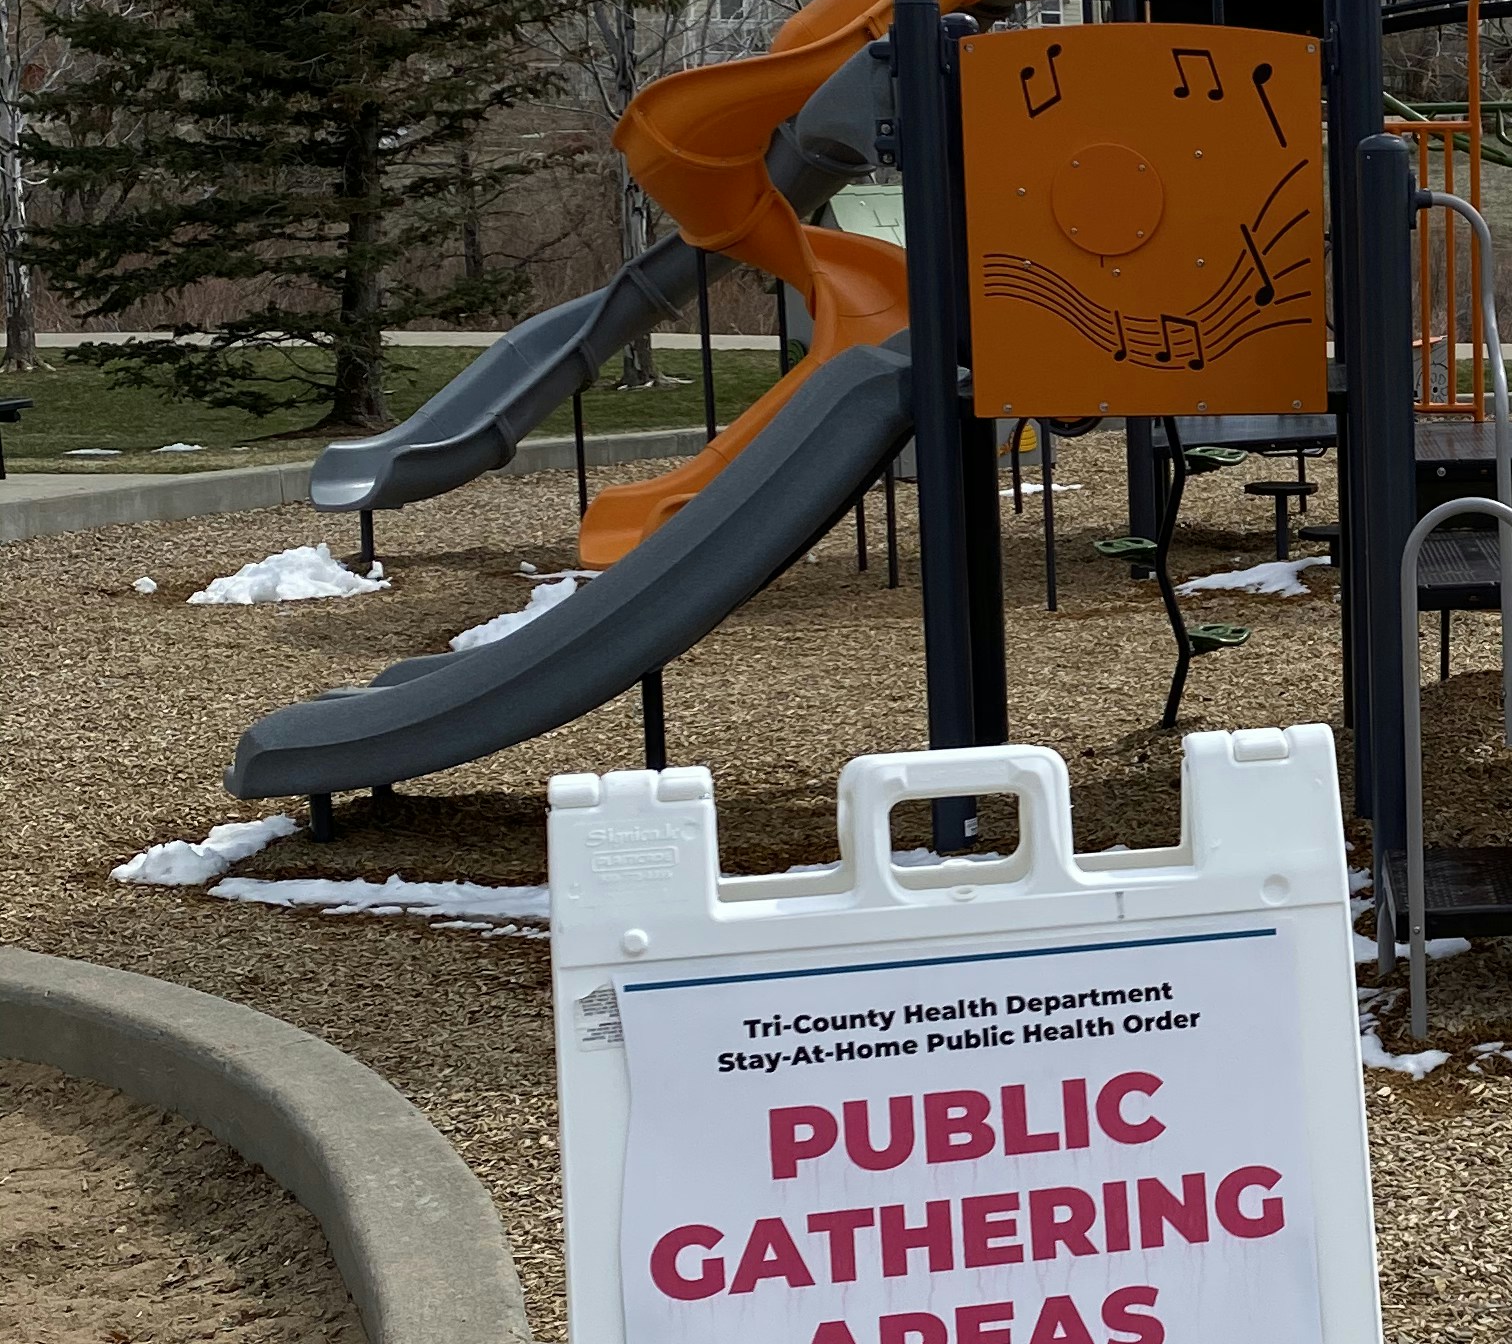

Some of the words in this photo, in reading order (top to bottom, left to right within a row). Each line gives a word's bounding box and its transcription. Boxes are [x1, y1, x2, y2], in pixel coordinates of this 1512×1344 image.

[717, 1039, 919, 1074] Stay-At-Home
[926, 1024, 1016, 1053] Public
[1022, 1016, 1115, 1044] Health
[1122, 1009, 1201, 1034] Order
[742, 1009, 896, 1039] Tri-County
[903, 997, 998, 1025] Health
[1006, 982, 1174, 1017] Department
[769, 1071, 1167, 1180] PUBLIC
[650, 1165, 1285, 1301] GATHERING
